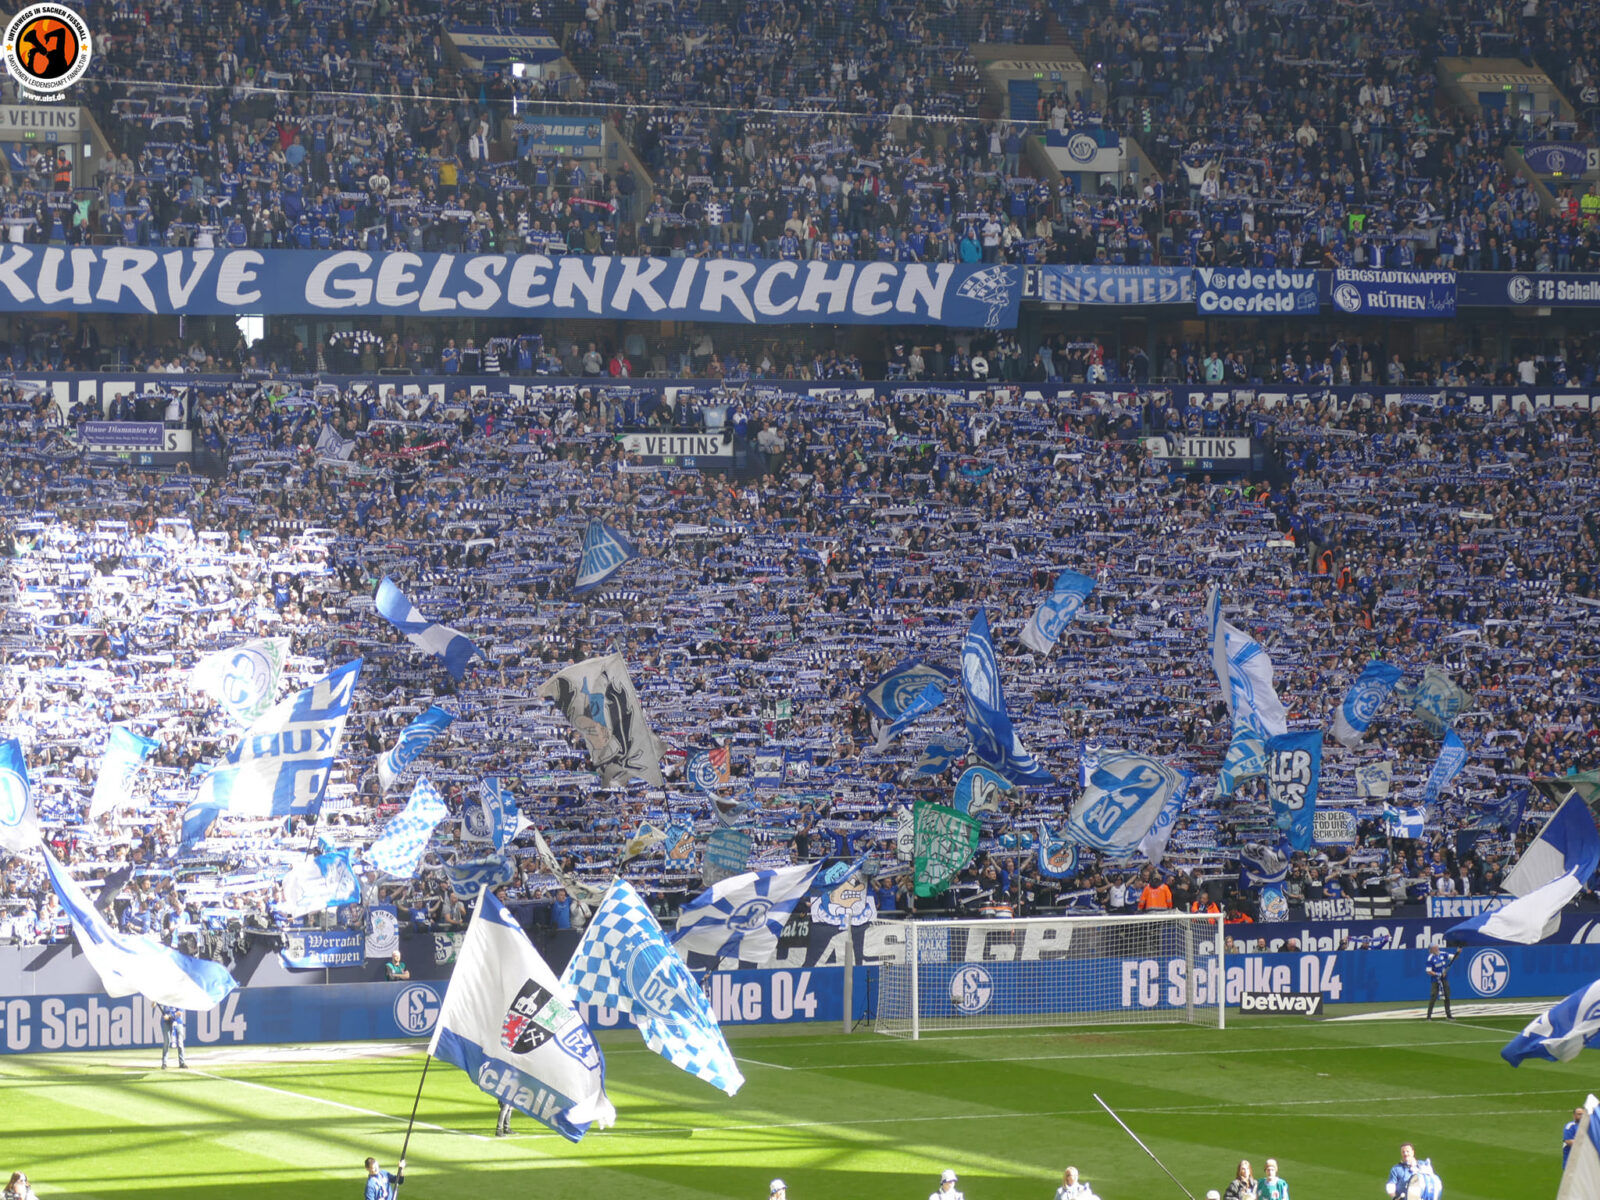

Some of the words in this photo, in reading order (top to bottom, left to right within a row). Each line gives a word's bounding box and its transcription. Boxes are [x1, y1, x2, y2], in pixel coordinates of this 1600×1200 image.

[8, 110, 77, 127] VELTINS
[305, 251, 955, 320] GELSENKIRCHEN
[1337, 270, 1456, 284] BERGSTADTKNAPPEN
[1044, 273, 1192, 303] ENSCHEDE
[1538, 281, 1555, 299] FC
[1200, 290, 1295, 312] Coesfeld
[1367, 291, 1426, 310] RÜTHEN
[108, 425, 147, 434] Diamanten
[645, 437, 719, 454] VELTINS
[1305, 899, 1355, 918] MARLER
[796, 921, 809, 936] 75
[1121, 958, 1159, 1007] FC
[1300, 955, 1343, 1000] 04
[771, 971, 818, 1020] 04
[1242, 992, 1321, 1016] betway
[0, 999, 31, 1050] C
[42, 995, 164, 1049] Schalk
